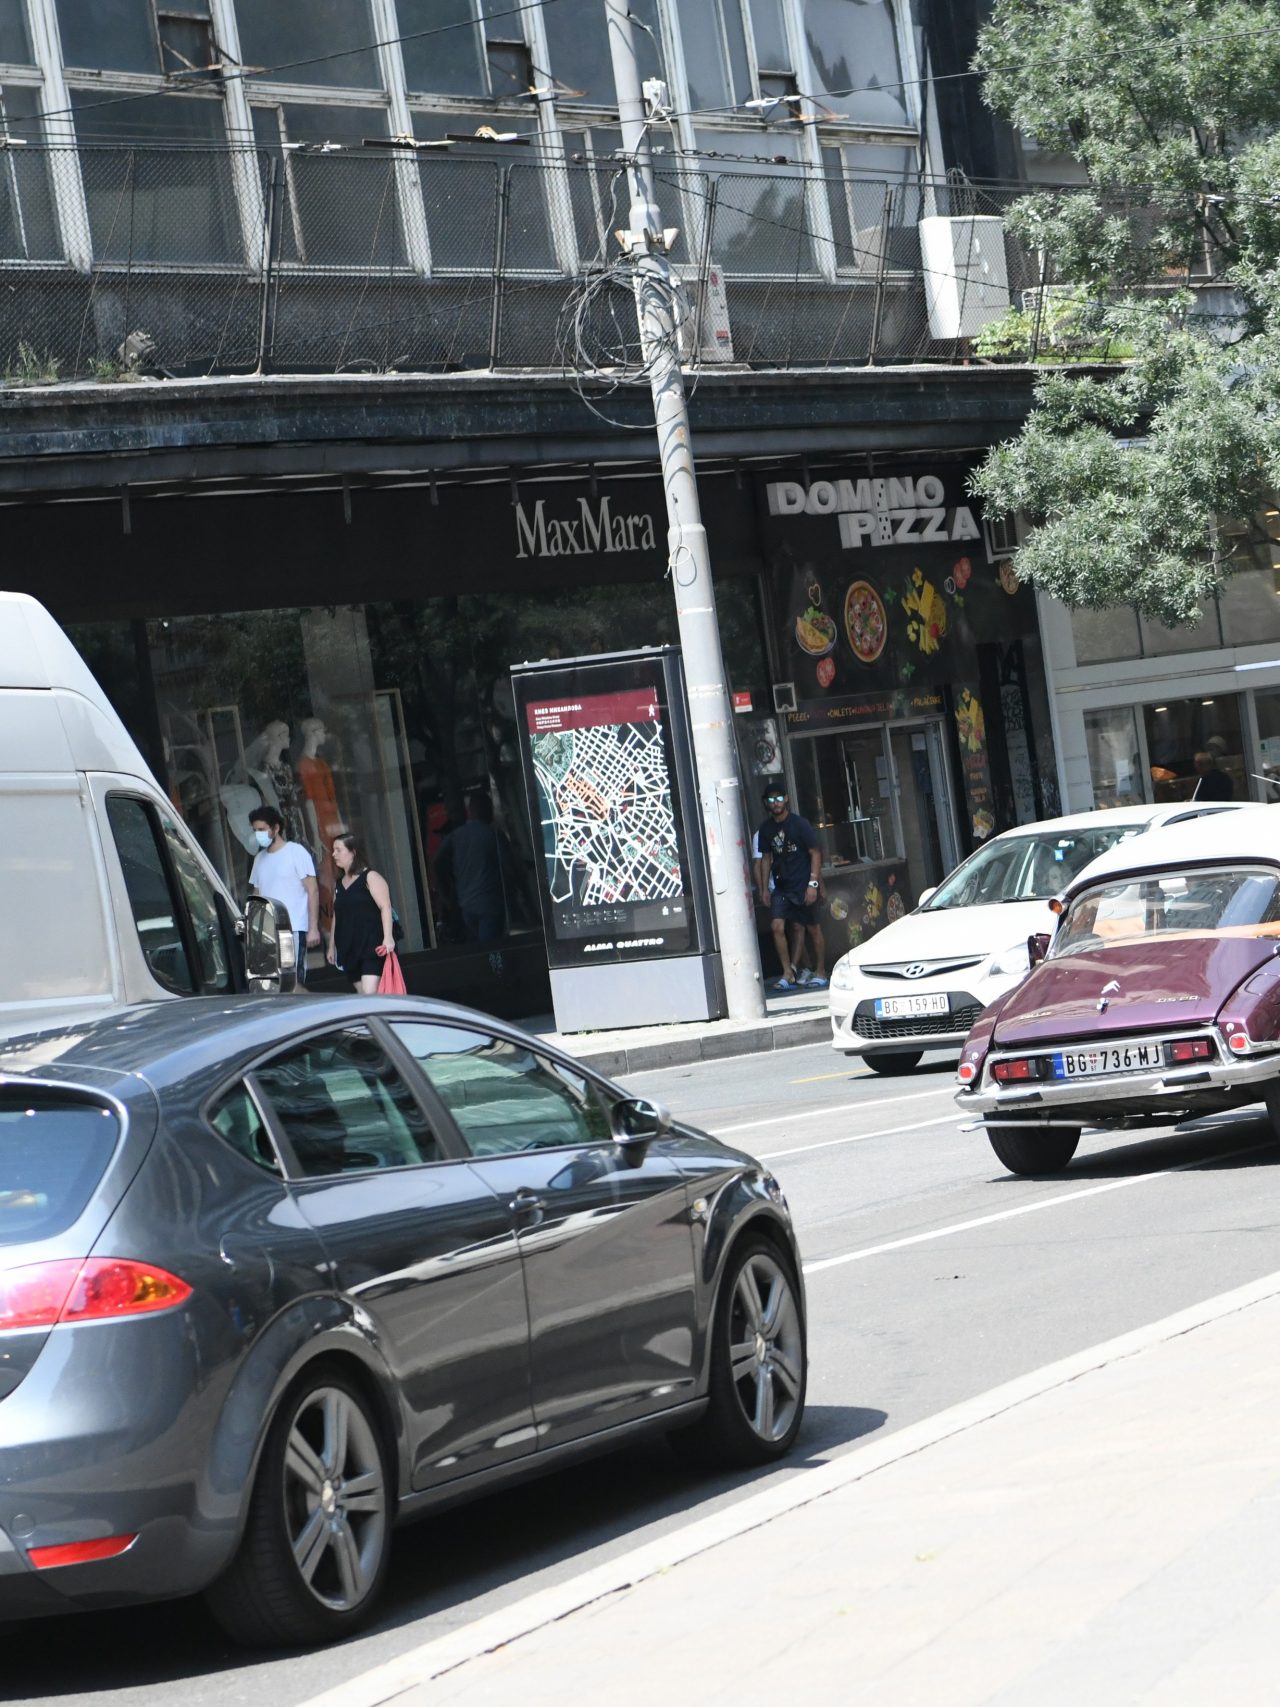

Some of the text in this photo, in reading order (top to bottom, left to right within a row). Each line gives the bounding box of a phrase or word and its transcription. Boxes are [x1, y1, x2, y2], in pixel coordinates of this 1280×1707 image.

[766, 475, 945, 516] DOMINO
[514, 496, 657, 558] MaxMara
[838, 506, 981, 549] PIZZA
[583, 937, 664, 952] ALMA QUATTRO
[884, 1000, 899, 1014] BG
[1065, 1053, 1087, 1075] BG
